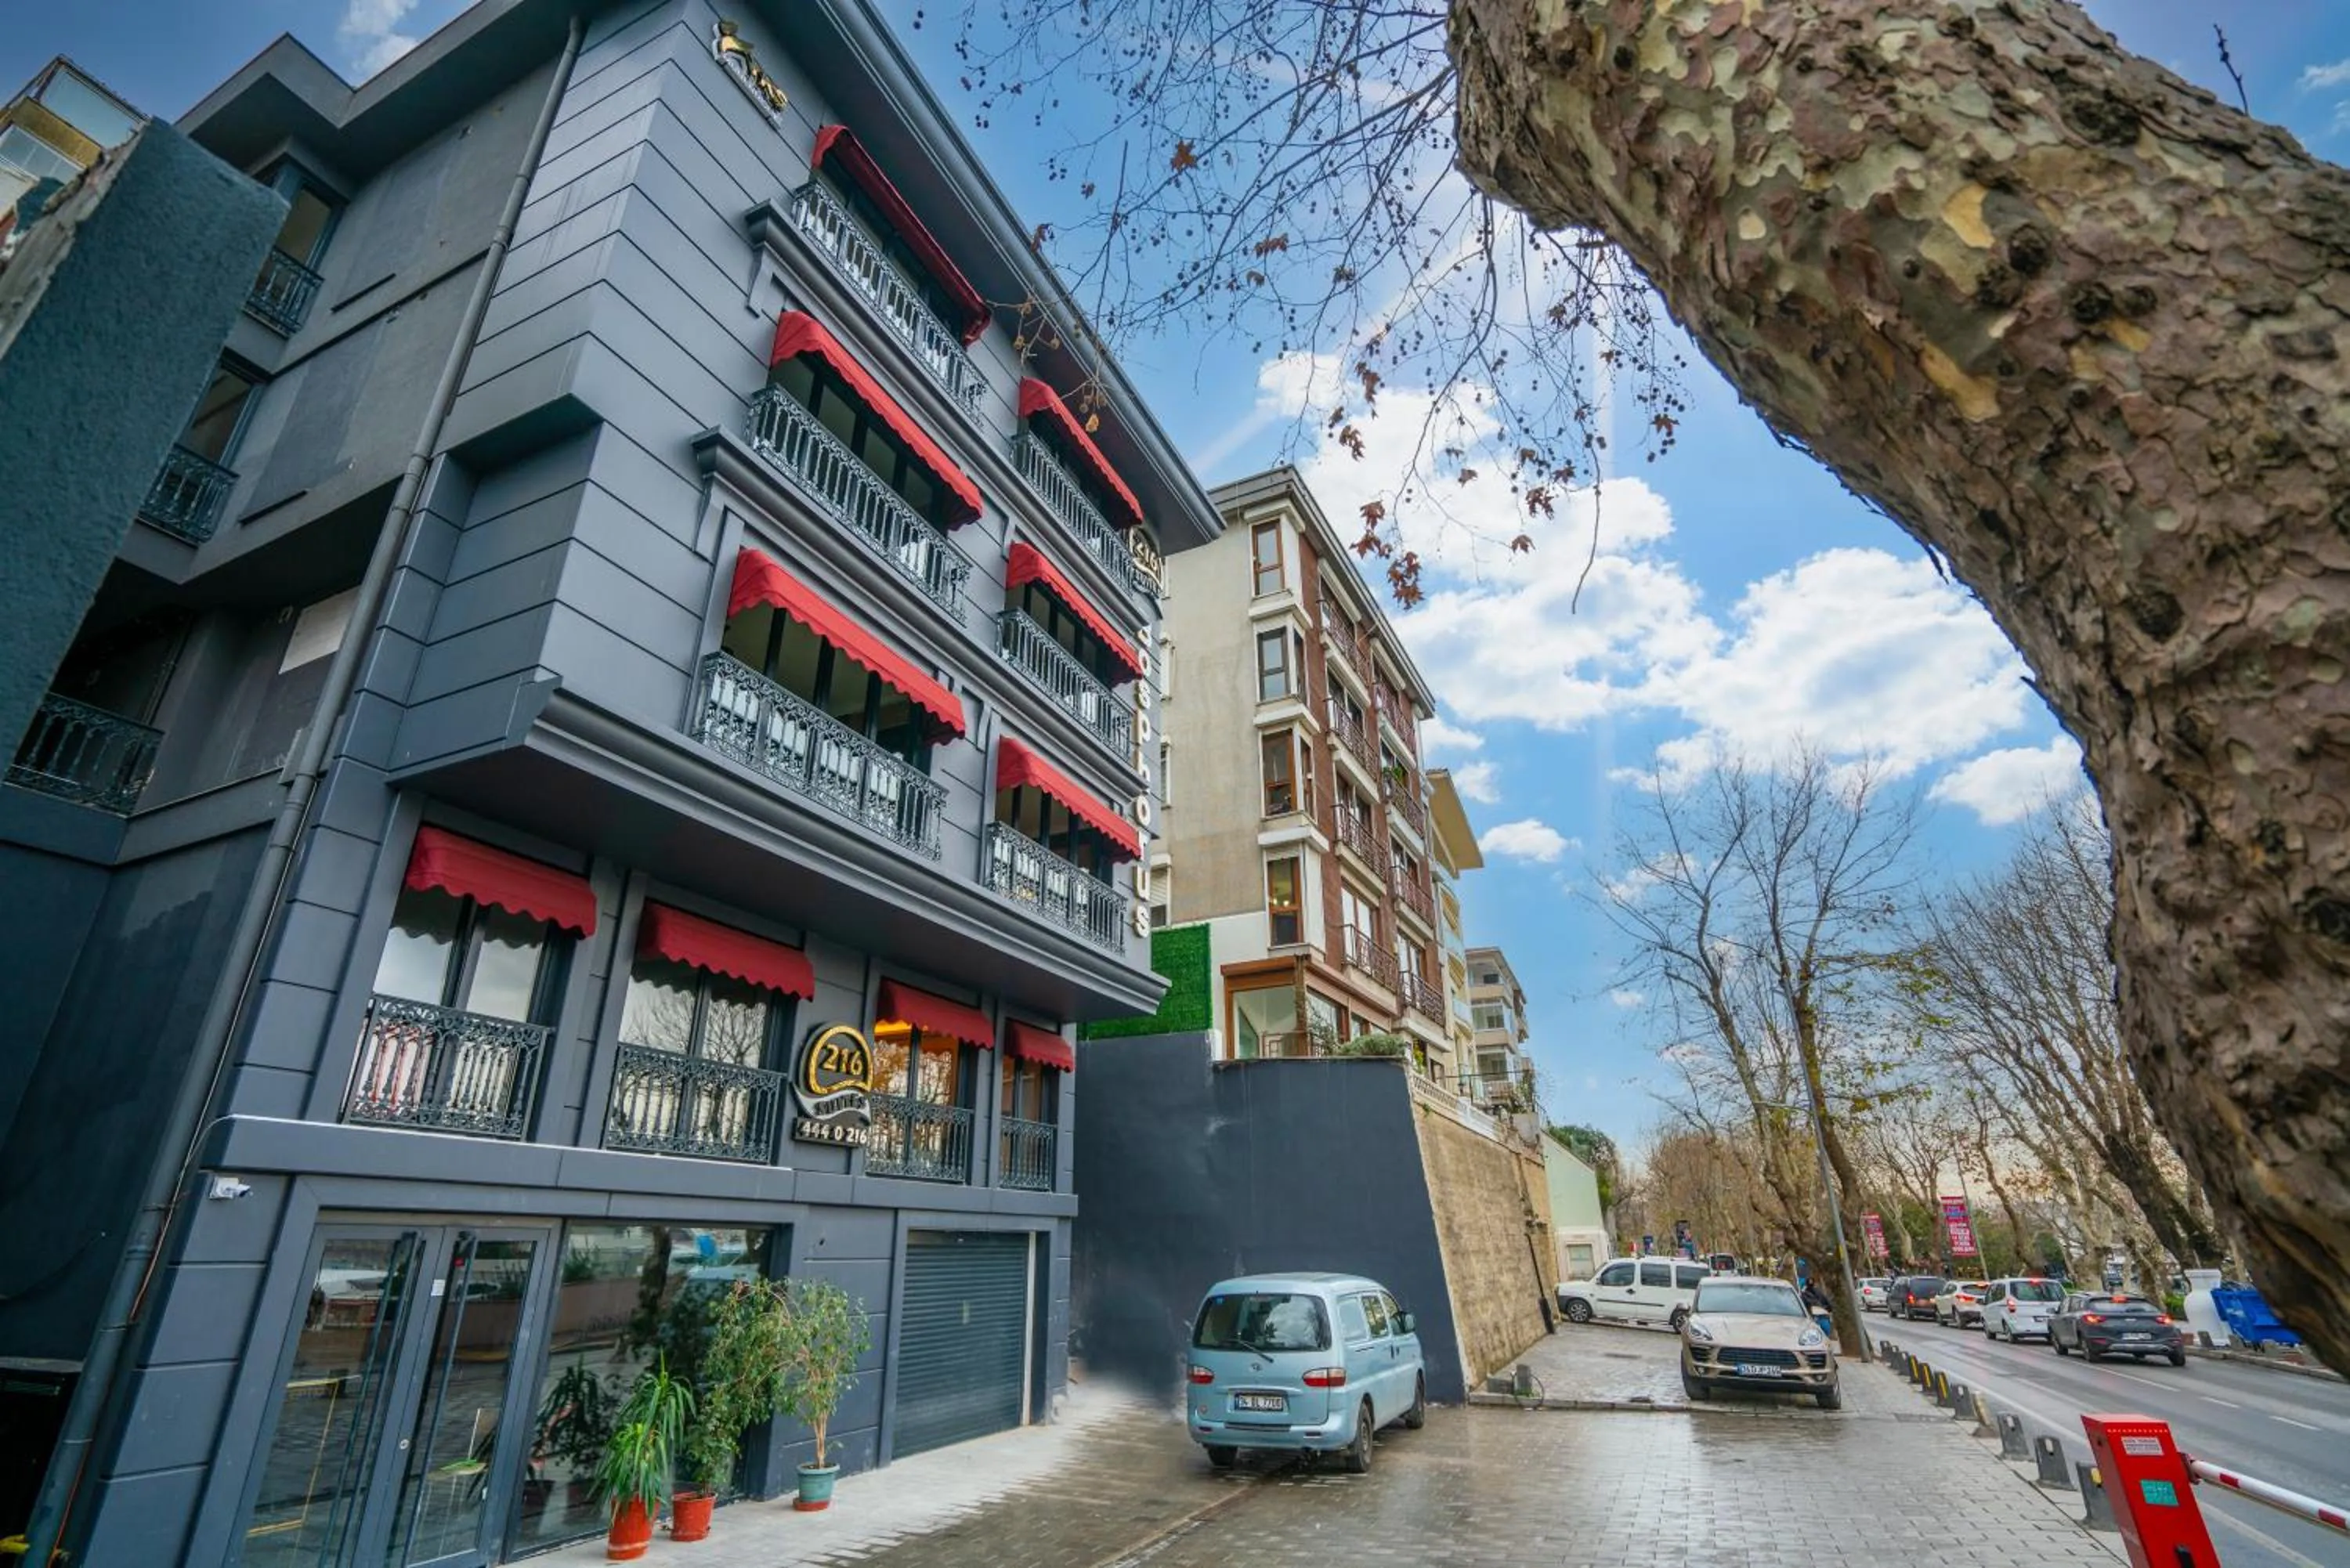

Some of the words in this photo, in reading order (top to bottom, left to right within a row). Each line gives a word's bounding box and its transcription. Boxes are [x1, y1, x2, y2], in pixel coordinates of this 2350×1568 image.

[823, 1043, 862, 1075] 216
[801, 1121, 830, 1140] 444
[834, 1125, 843, 1141] 0
[847, 1127, 867, 1144] 216
